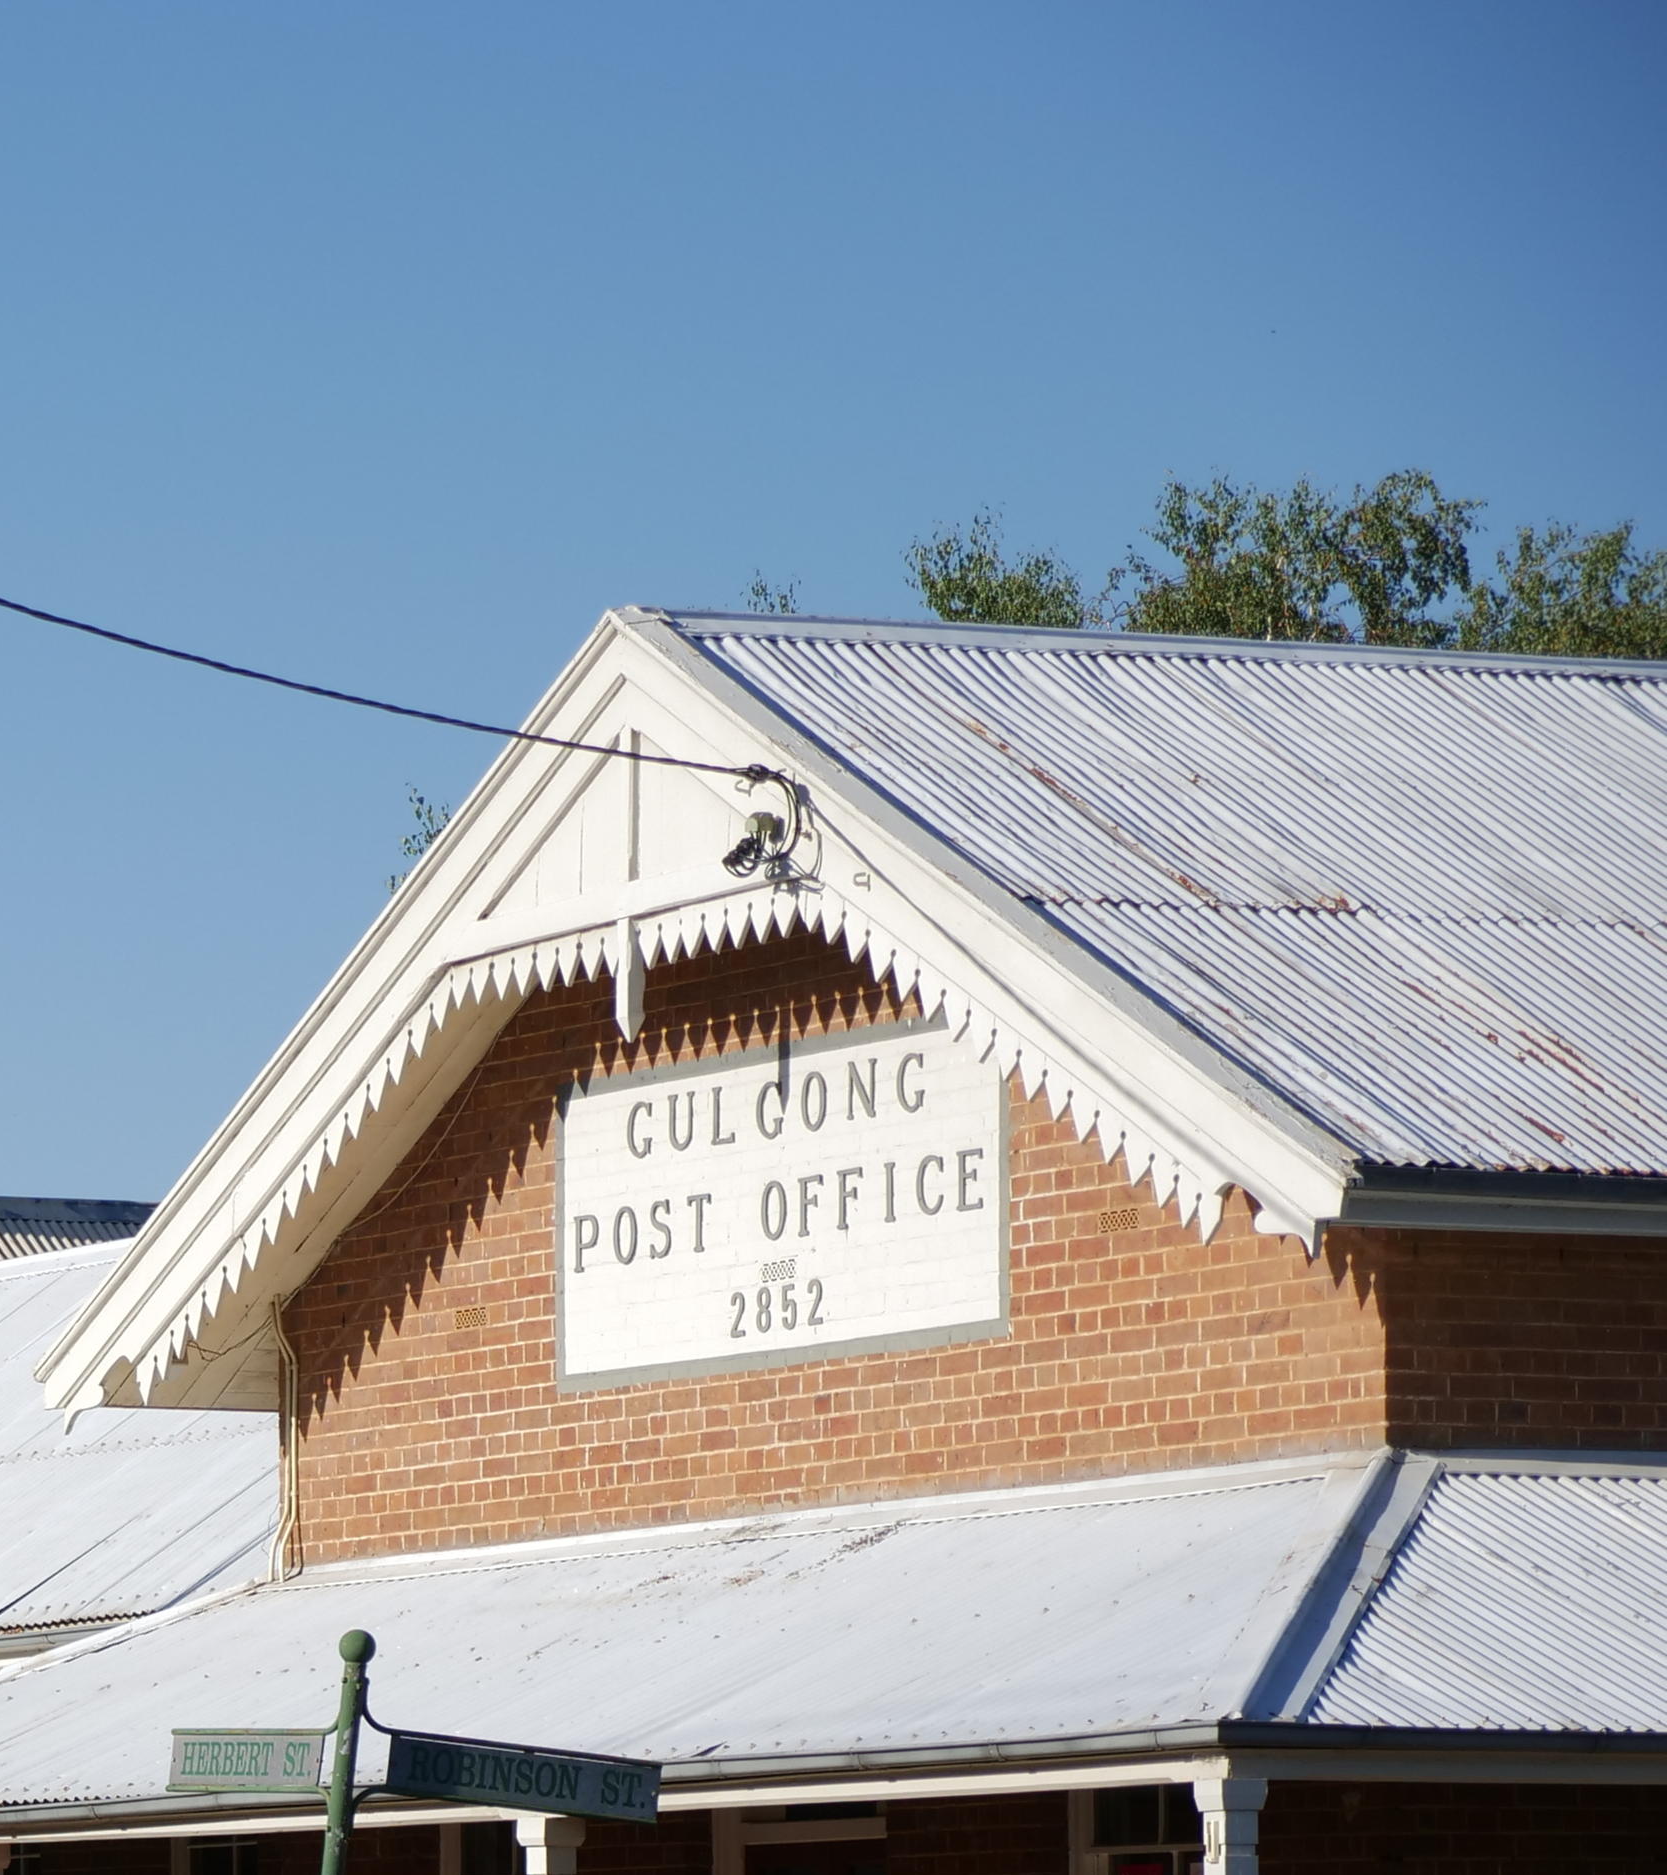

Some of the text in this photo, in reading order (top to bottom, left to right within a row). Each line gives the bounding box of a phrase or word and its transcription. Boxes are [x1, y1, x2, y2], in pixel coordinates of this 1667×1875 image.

[626, 1052, 926, 1159] GULGONG
[573, 1147, 984, 1273] POST OFFICE
[730, 1278, 824, 1338] 2852
[181, 1741, 312, 1777] HERBERT ST.
[408, 1745, 646, 1809] ROBINSON ST.
